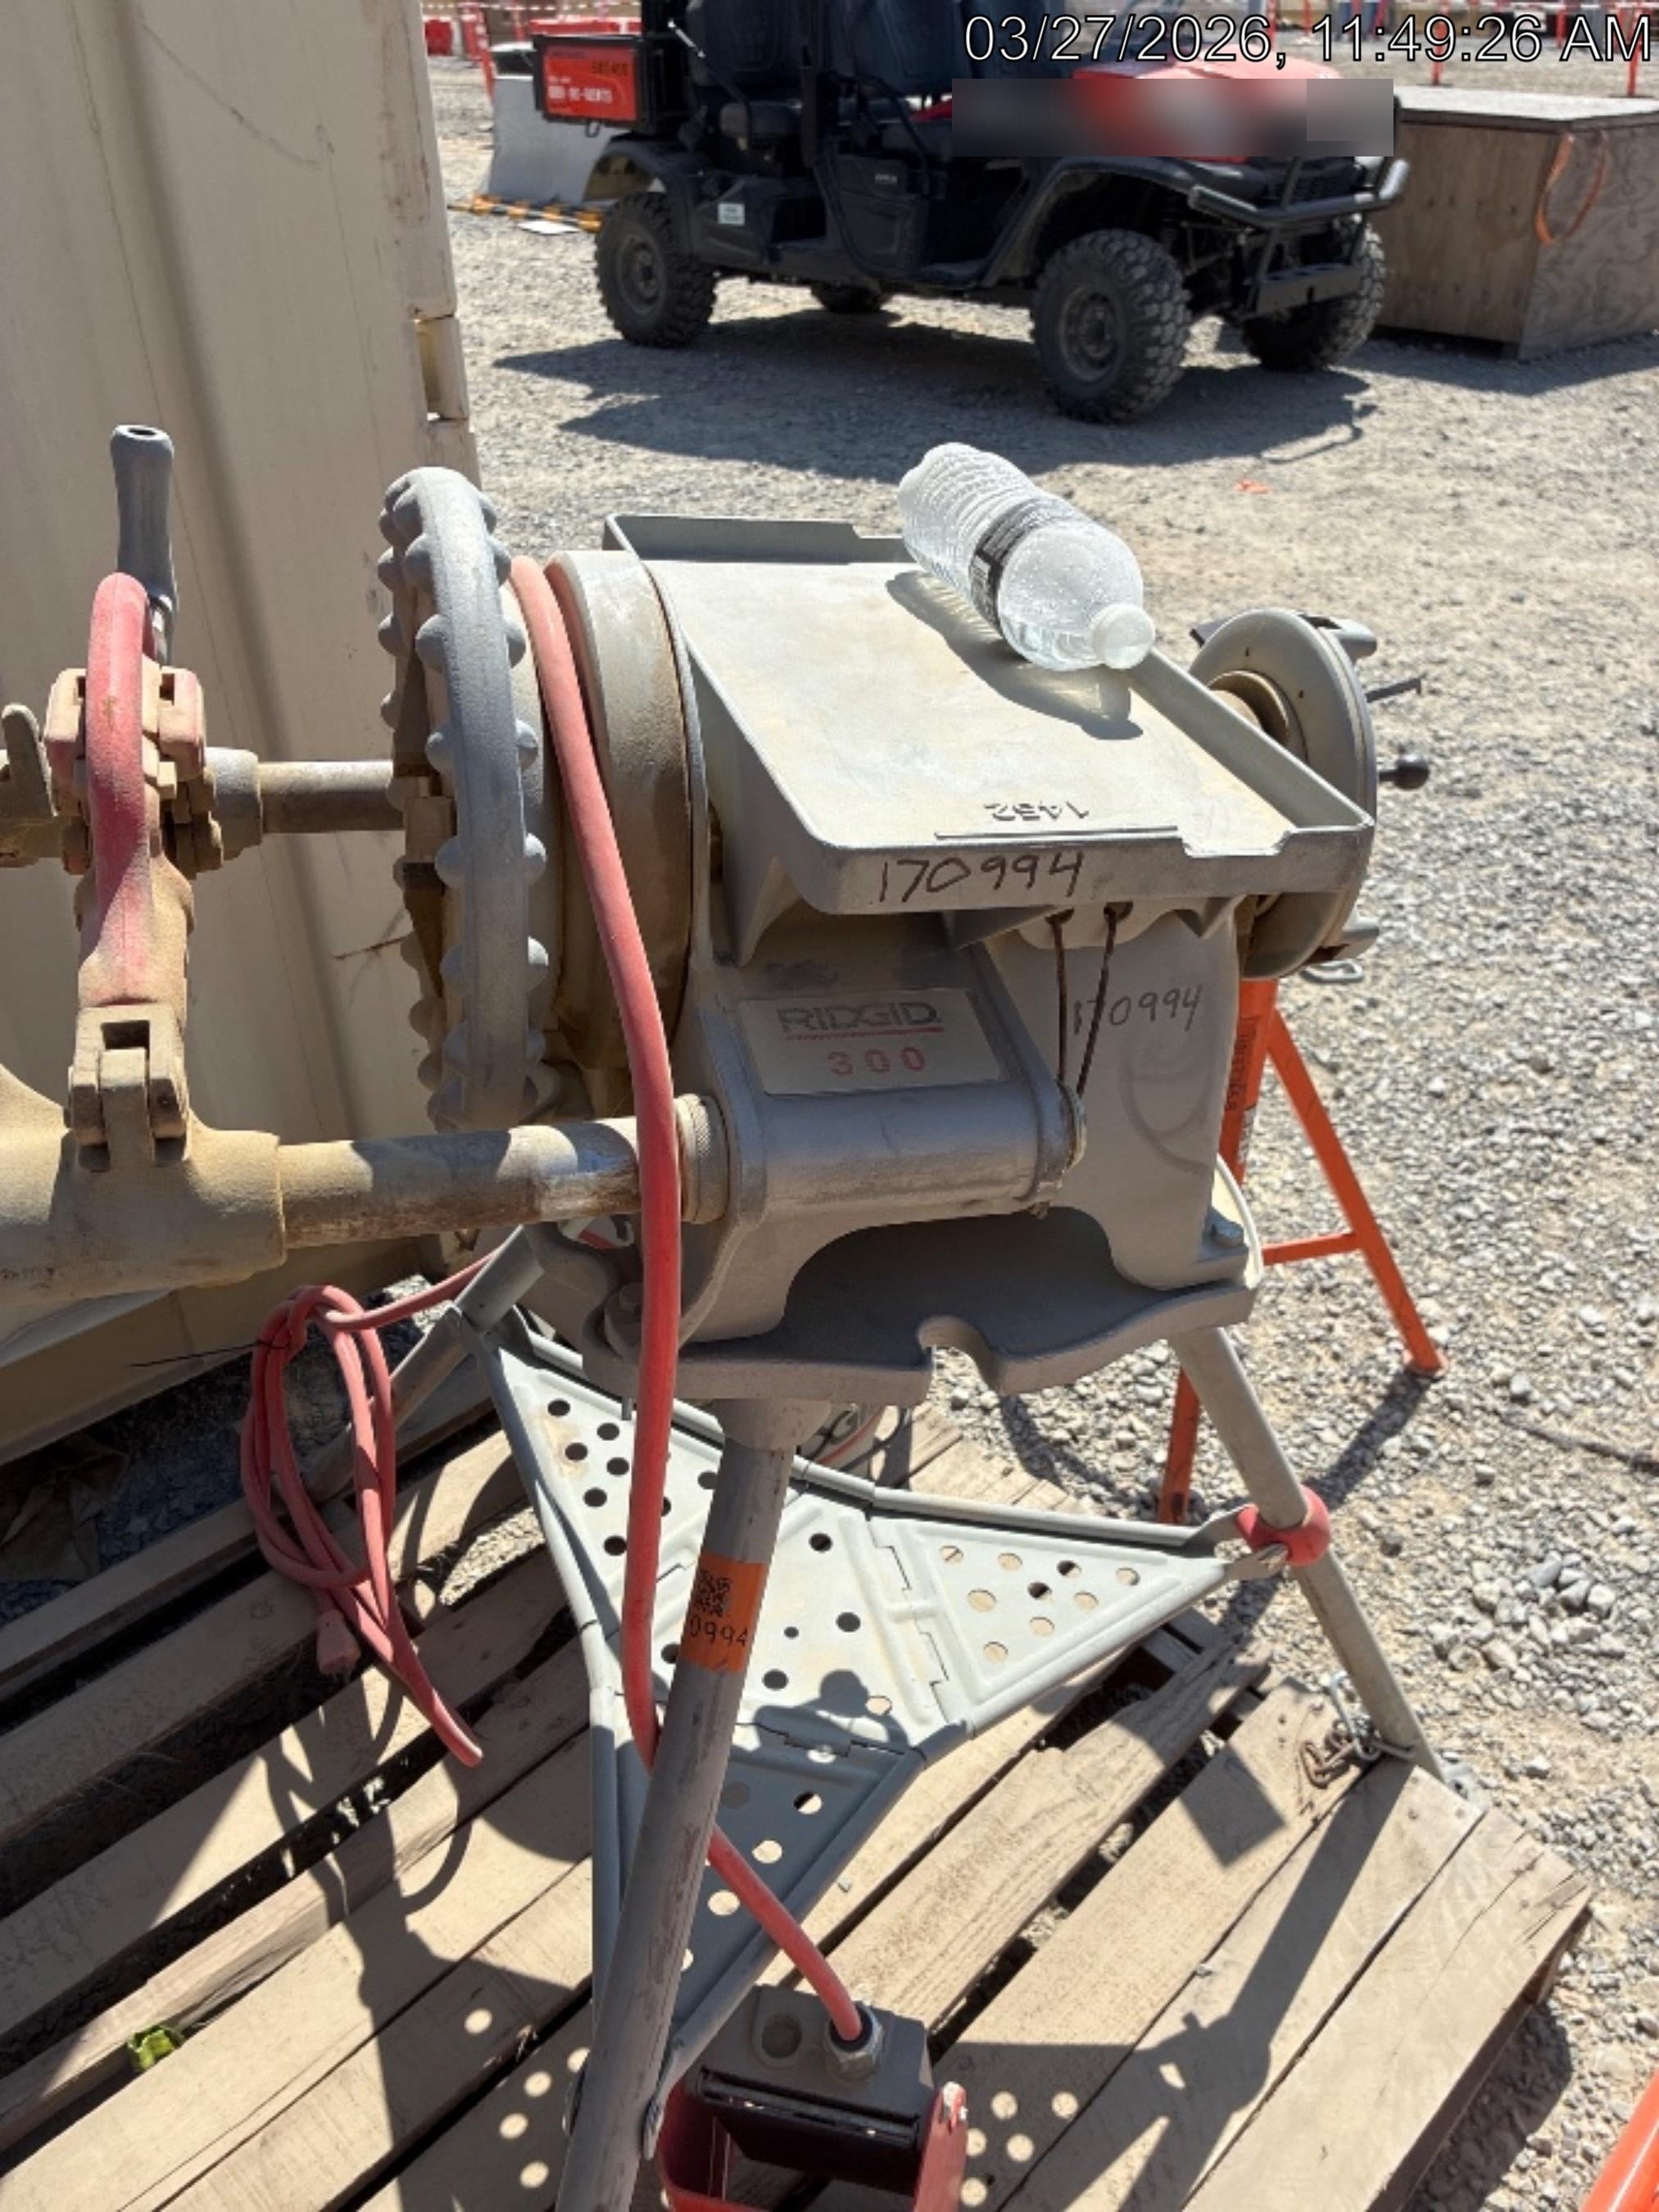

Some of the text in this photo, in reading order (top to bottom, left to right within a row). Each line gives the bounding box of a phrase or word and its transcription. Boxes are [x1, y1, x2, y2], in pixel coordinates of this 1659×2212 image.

[879, 850, 1086, 903] 170994
[777, 1001, 939, 1033] RIDGID
[827, 1046, 926, 1077] 300
